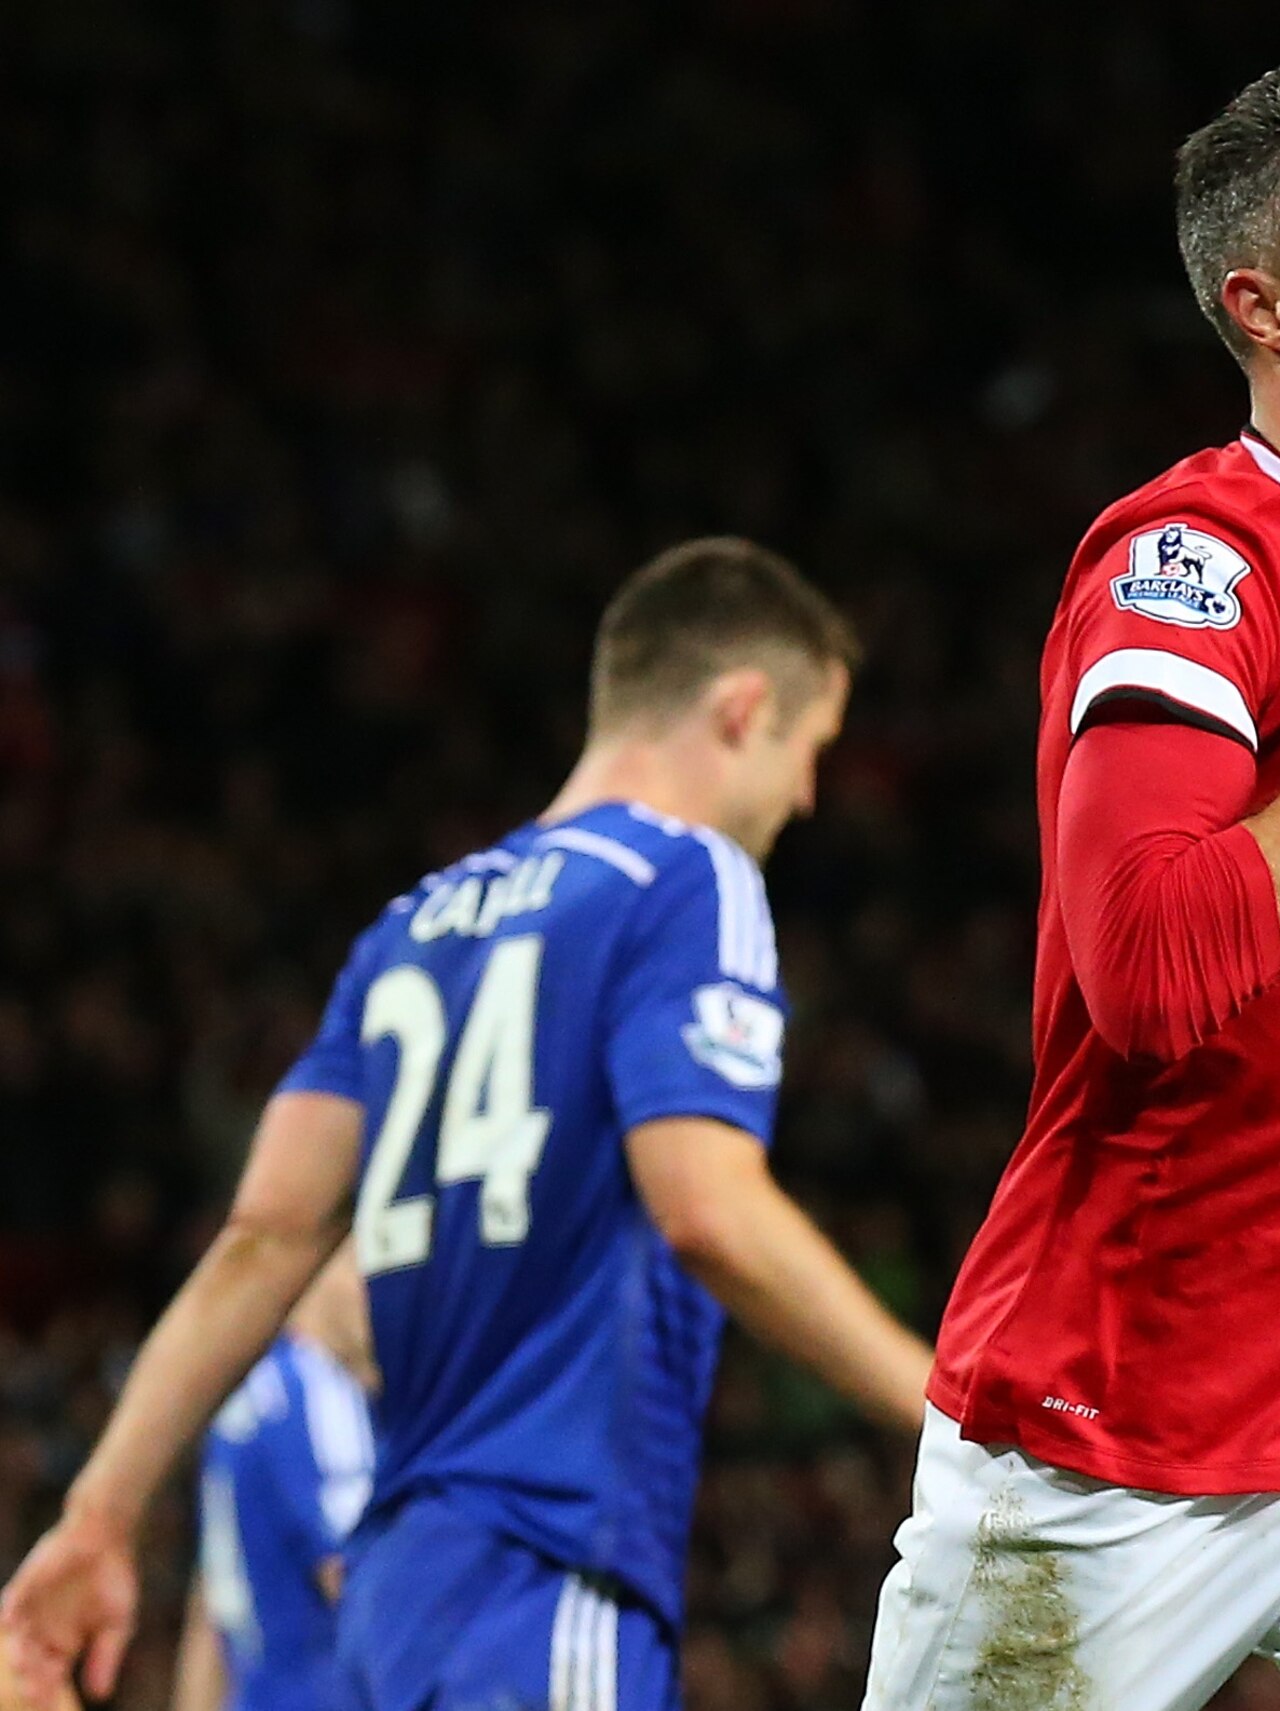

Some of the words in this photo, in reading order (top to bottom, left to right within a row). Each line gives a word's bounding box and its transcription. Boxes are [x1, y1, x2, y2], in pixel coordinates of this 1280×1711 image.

[1129, 580, 1205, 601] BARCLAYS
[353, 934, 552, 1279] 24
[1042, 1396, 1100, 1420] DRI-FIT
